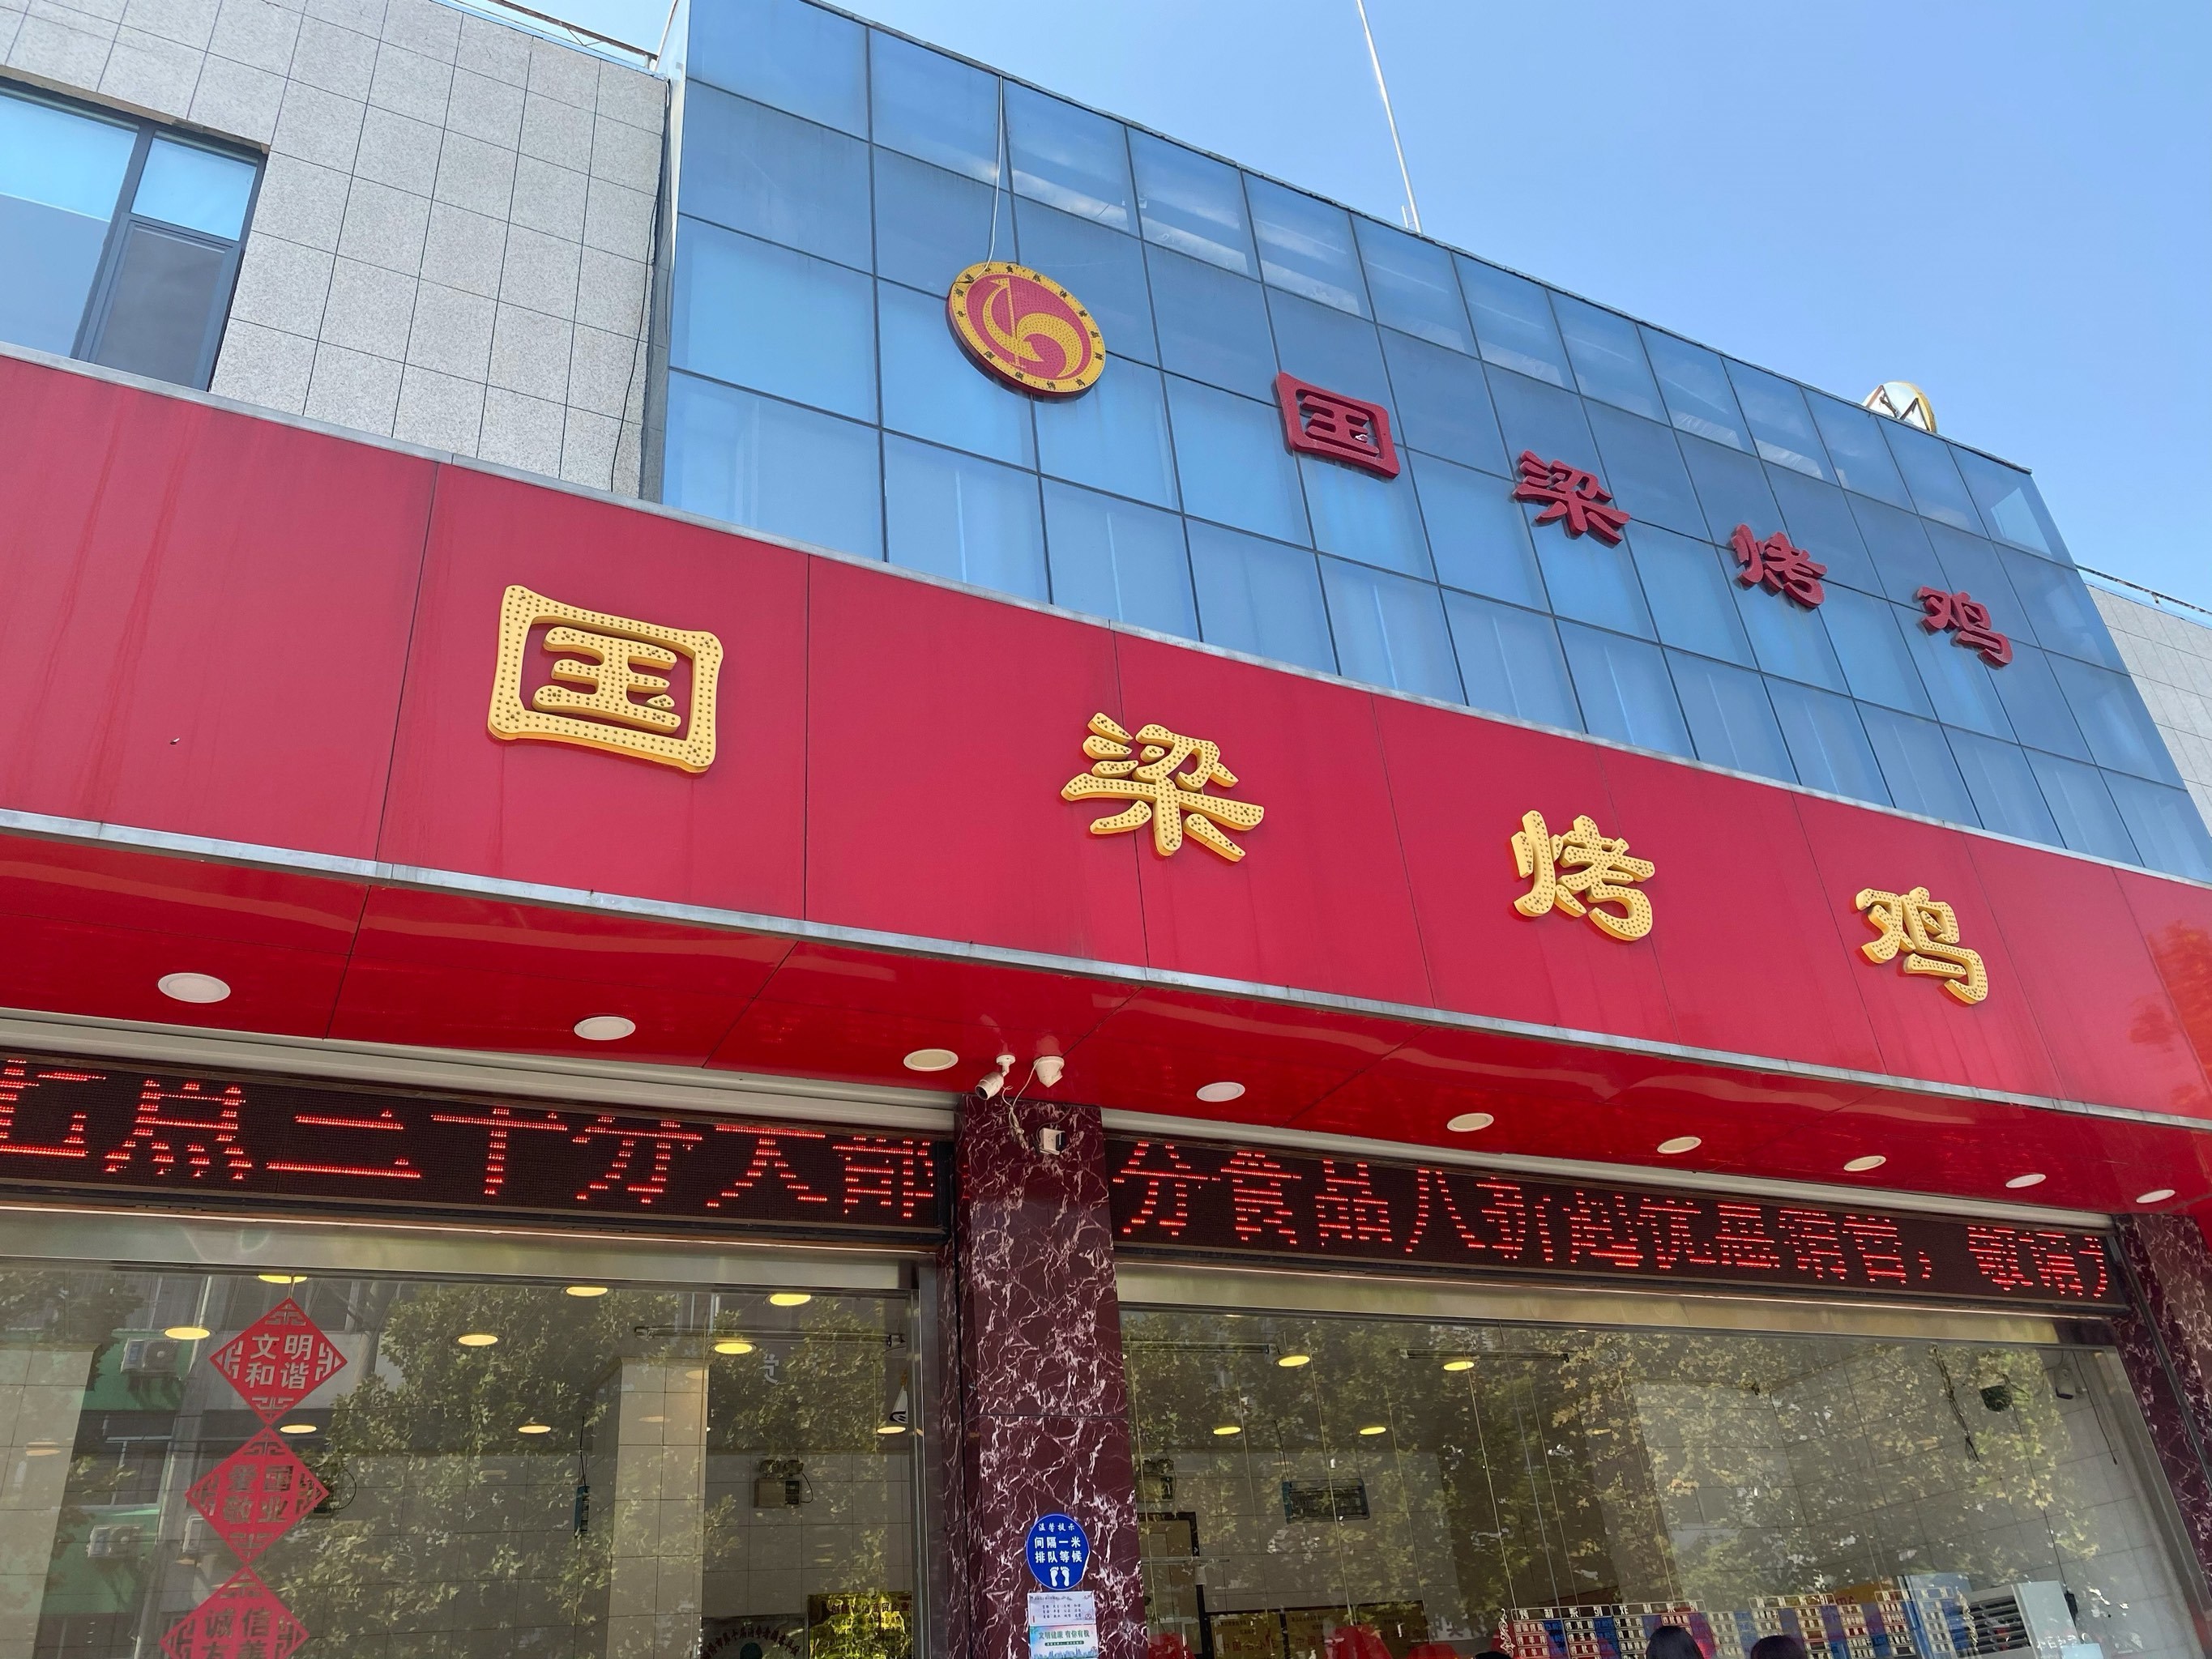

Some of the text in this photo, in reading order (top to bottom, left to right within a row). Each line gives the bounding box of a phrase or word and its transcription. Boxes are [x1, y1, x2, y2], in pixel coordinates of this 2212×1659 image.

[1275, 373, 2013, 668] 国梁烤鸡
[487, 584, 1992, 1004] 国梁烤鸡
[250, 1333, 314, 1361] 文明
[245, 1361, 310, 1390] 和谐
[227, 1464, 294, 1494] 爱国
[223, 1495, 288, 1525] 敬业
[1038, 1522, 1075, 1533] 温馨提示
[1034, 1536, 1082, 1549] 间隔一米
[1035, 1550, 1083, 1563] 排队等候
[204, 1606, 272, 1638] 诚信
